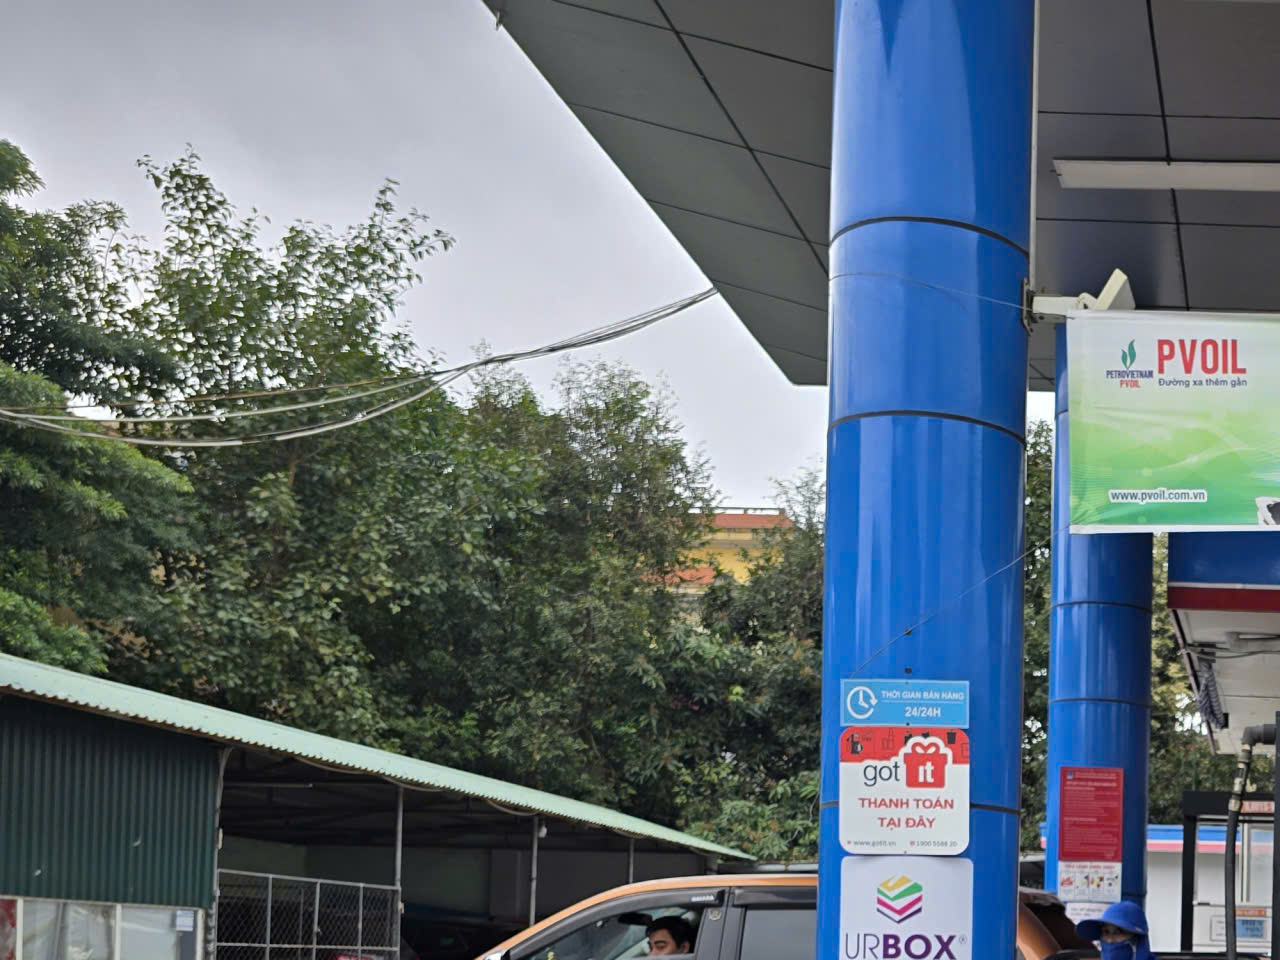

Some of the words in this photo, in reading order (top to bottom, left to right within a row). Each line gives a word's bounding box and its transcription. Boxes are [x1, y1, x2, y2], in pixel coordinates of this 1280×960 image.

[1157, 339, 1247, 374] PVOIL
[1106, 369, 1154, 379] PETROVIETNAM
[1120, 380, 1141, 388] PVOIL
[1158, 378, 1190, 388] Đường
[1192, 379, 1203, 387] xa
[1206, 378, 1228, 387] thêm
[1230, 376, 1248, 388] gần
[1111, 490, 1206, 502] www.pvoil.com.vn
[902, 690, 921, 699] GIAN
[905, 706, 941, 717] 24/24H
[863, 761, 900, 787] got
[918, 762, 935, 783] it
[858, 797, 909, 809] THANH
[913, 797, 954, 810] TOÁN
[877, 817, 901, 831] TẠI
[905, 815, 936, 829] ĐÂY
[845, 933, 957, 960] URBOX
